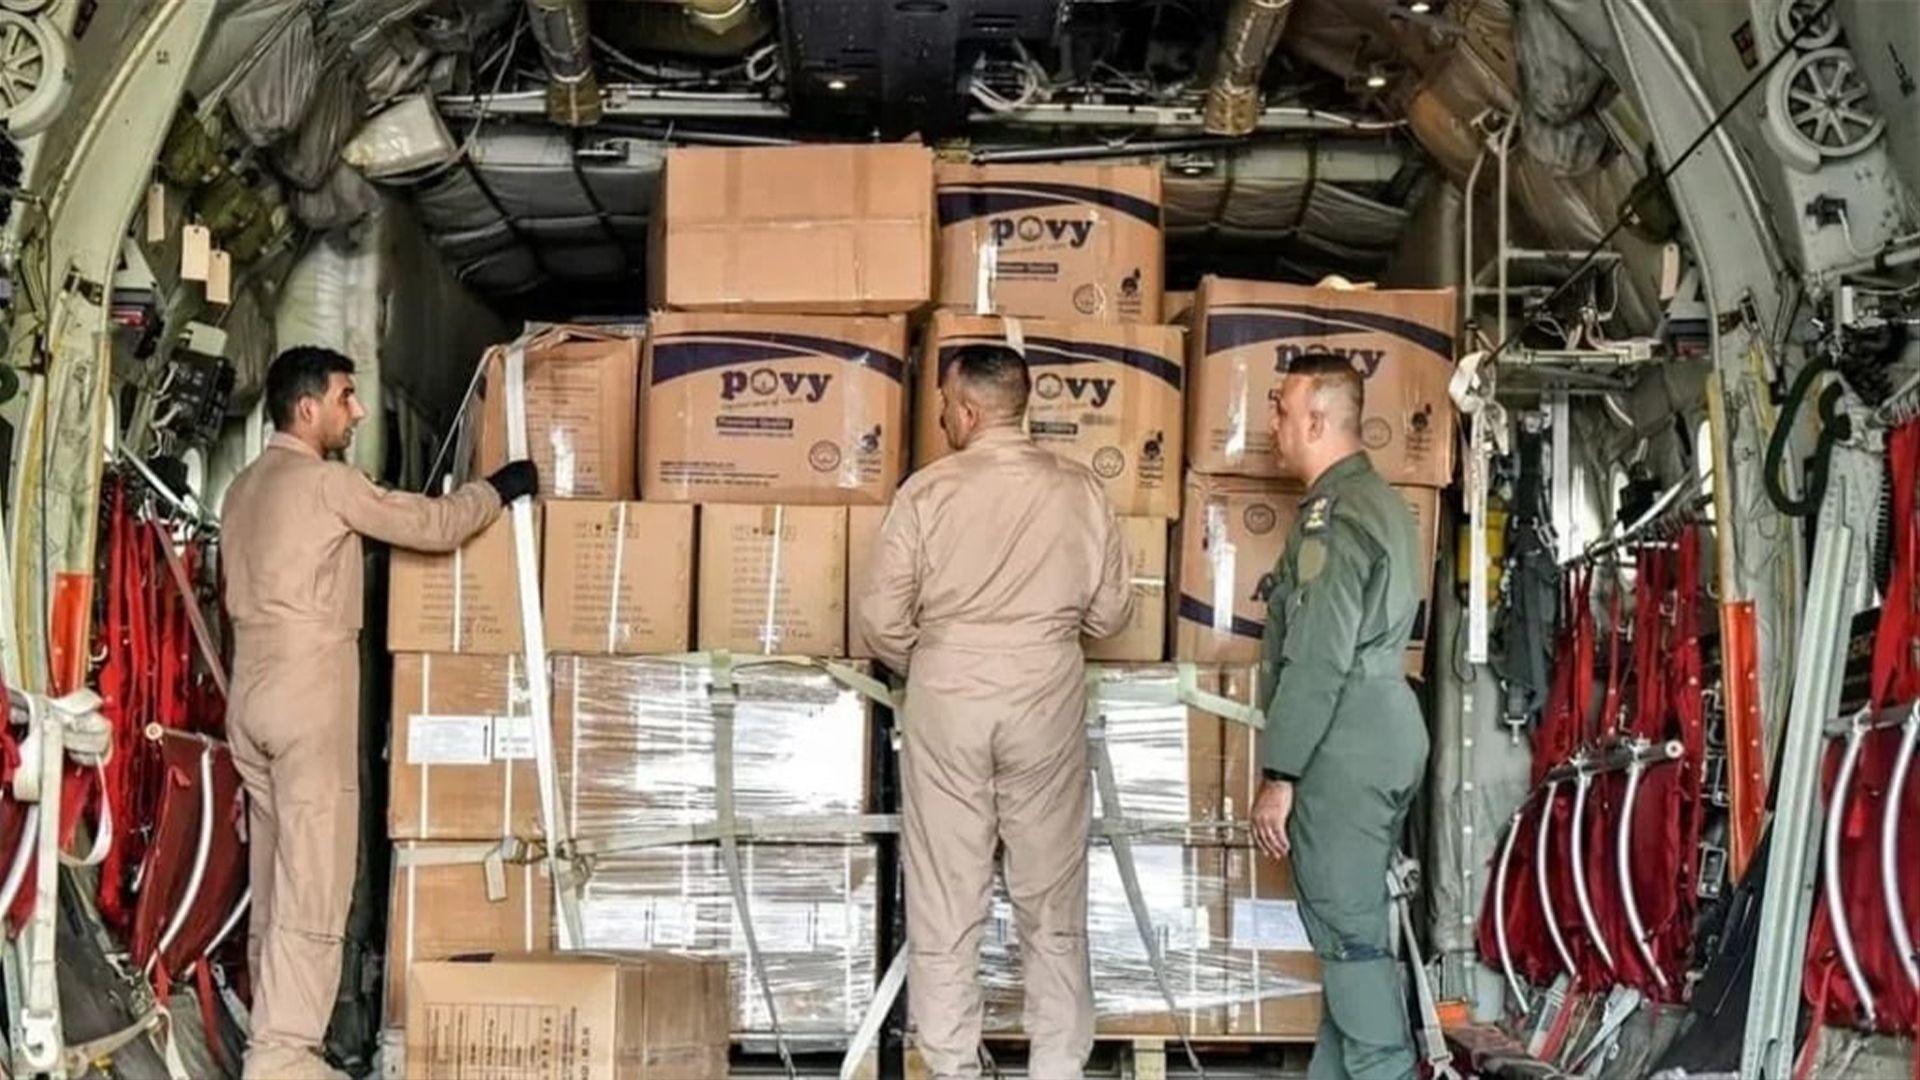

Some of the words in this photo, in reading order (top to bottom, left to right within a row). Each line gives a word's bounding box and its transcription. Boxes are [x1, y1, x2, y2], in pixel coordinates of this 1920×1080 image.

[990, 215, 1093, 249] povy
[721, 368, 832, 402] povy
[1036, 373, 1116, 408] ovy
